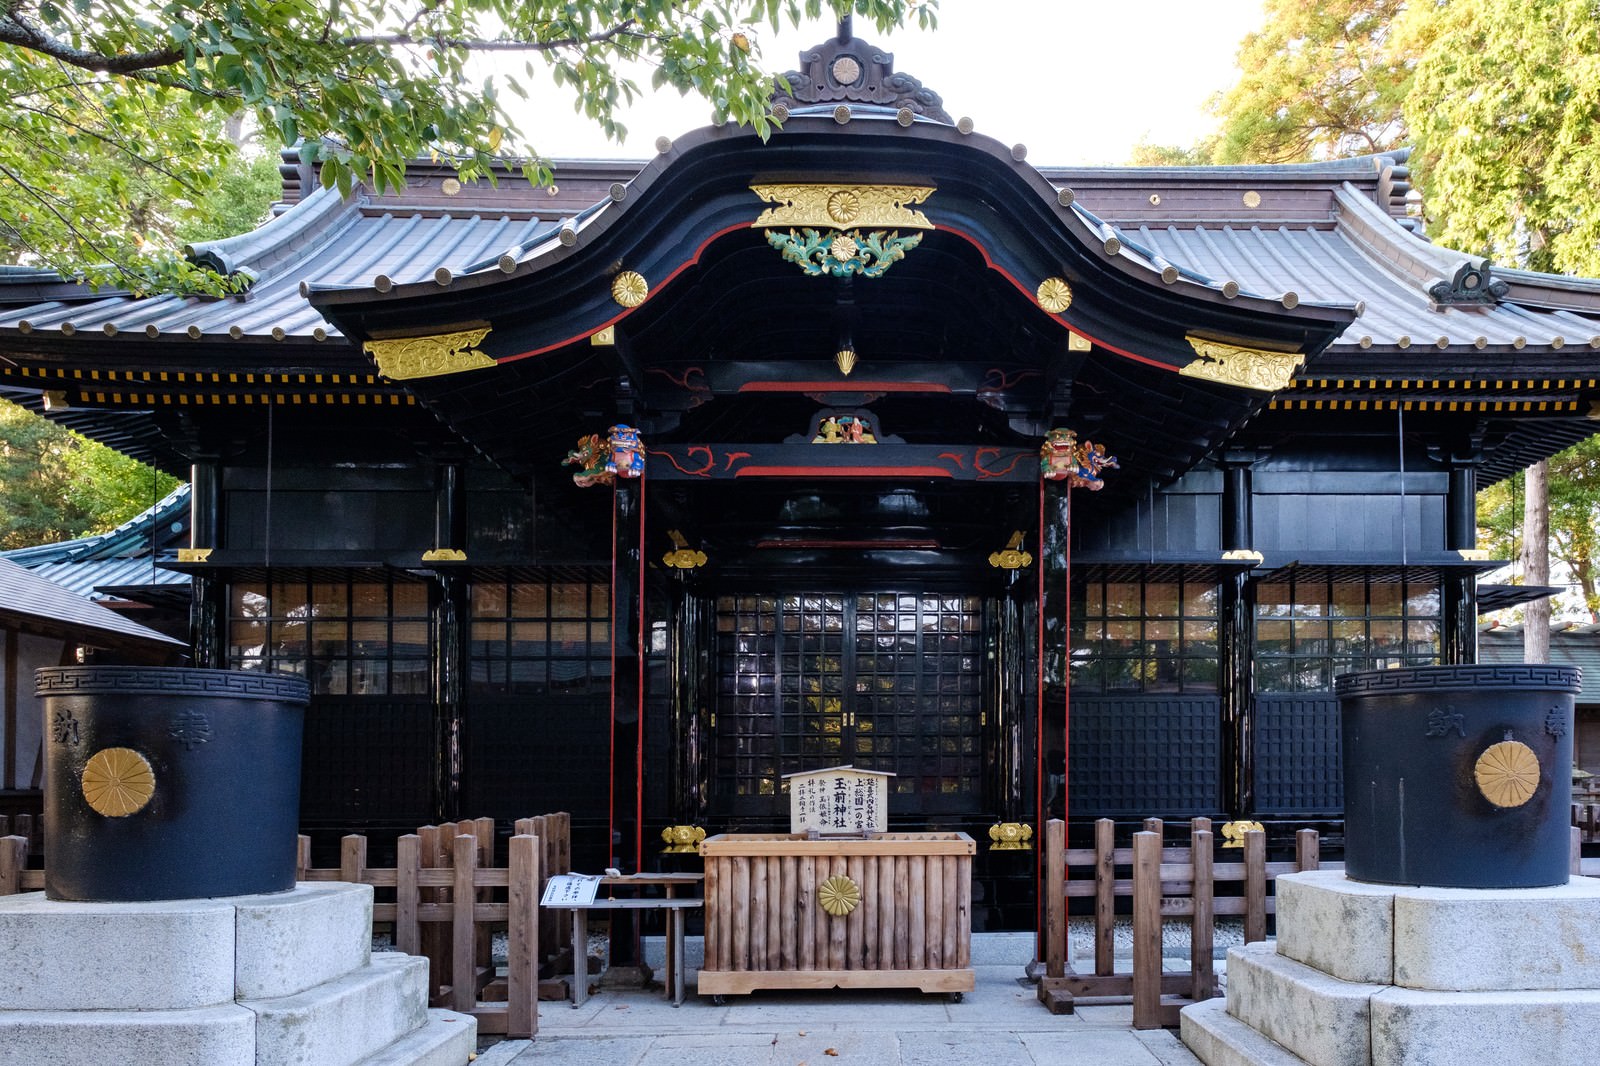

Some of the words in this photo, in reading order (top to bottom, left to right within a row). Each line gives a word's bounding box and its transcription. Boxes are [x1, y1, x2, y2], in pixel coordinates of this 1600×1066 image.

[833, 778, 847, 828] 玉前神社
[854, 778, 864, 828] 上総国一の宮
